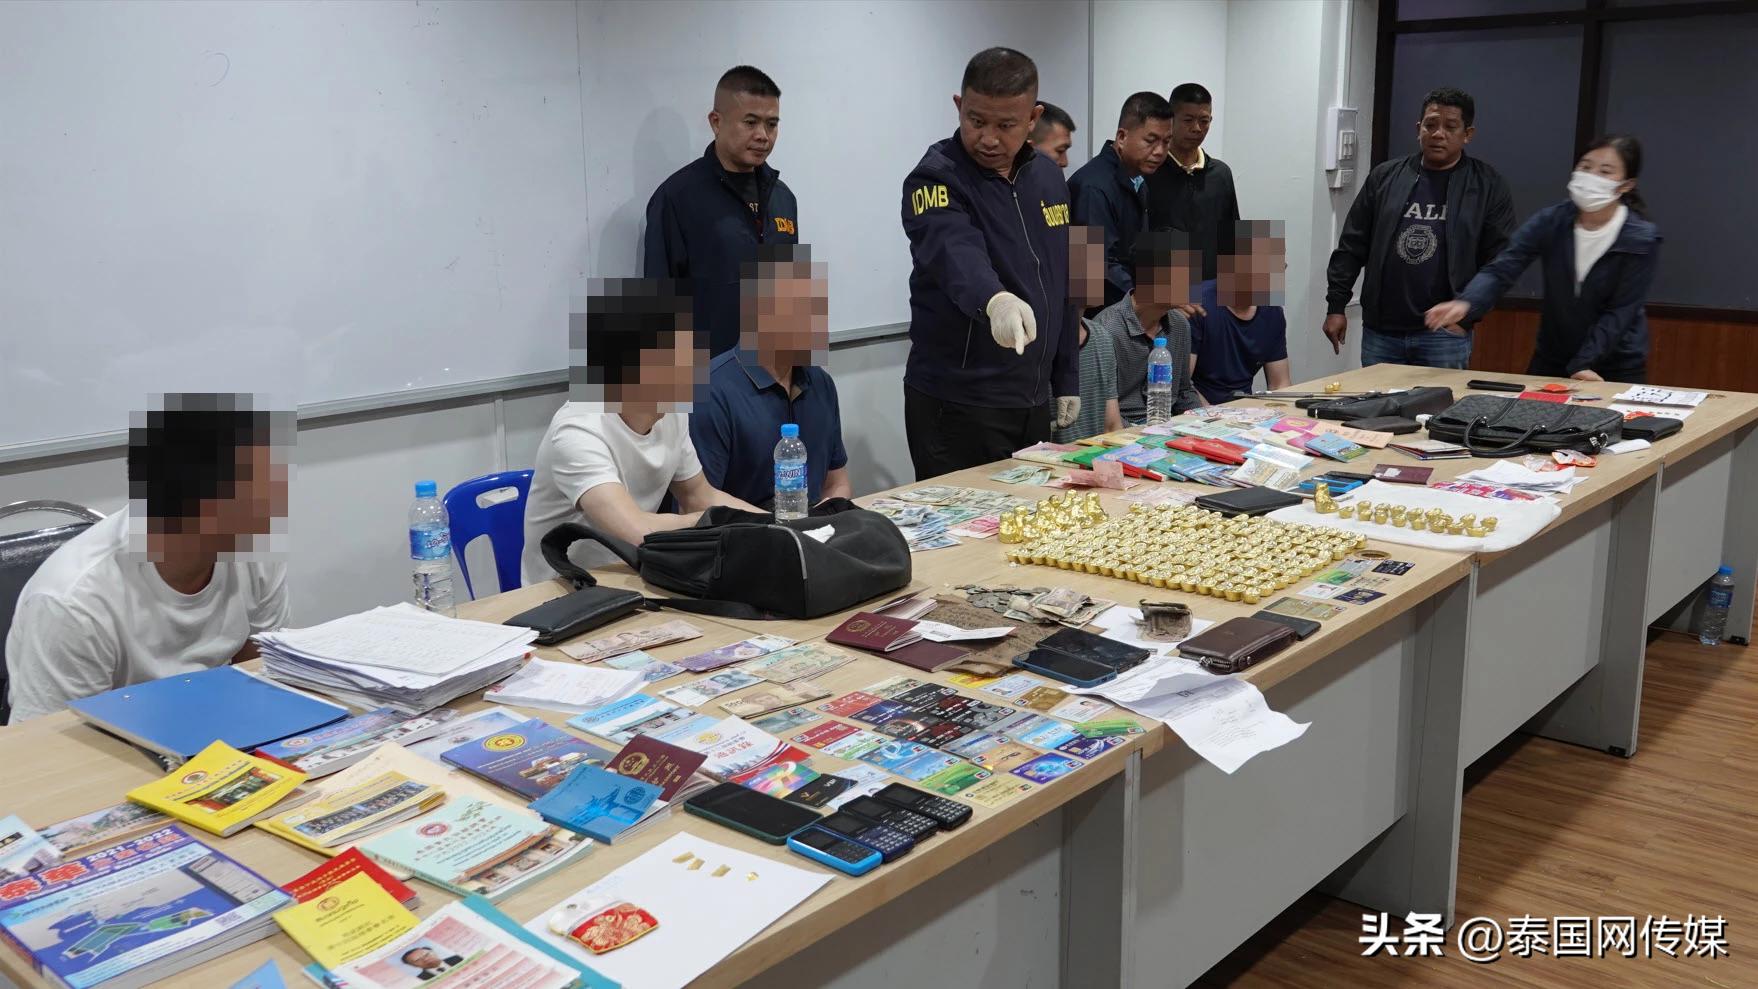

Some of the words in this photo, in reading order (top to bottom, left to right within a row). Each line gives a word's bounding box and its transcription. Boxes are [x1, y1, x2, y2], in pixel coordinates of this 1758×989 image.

[912, 185, 949, 216] IDMB
[1403, 202, 1447, 220] AL
[86, 828, 173, 863] 2021-2022
